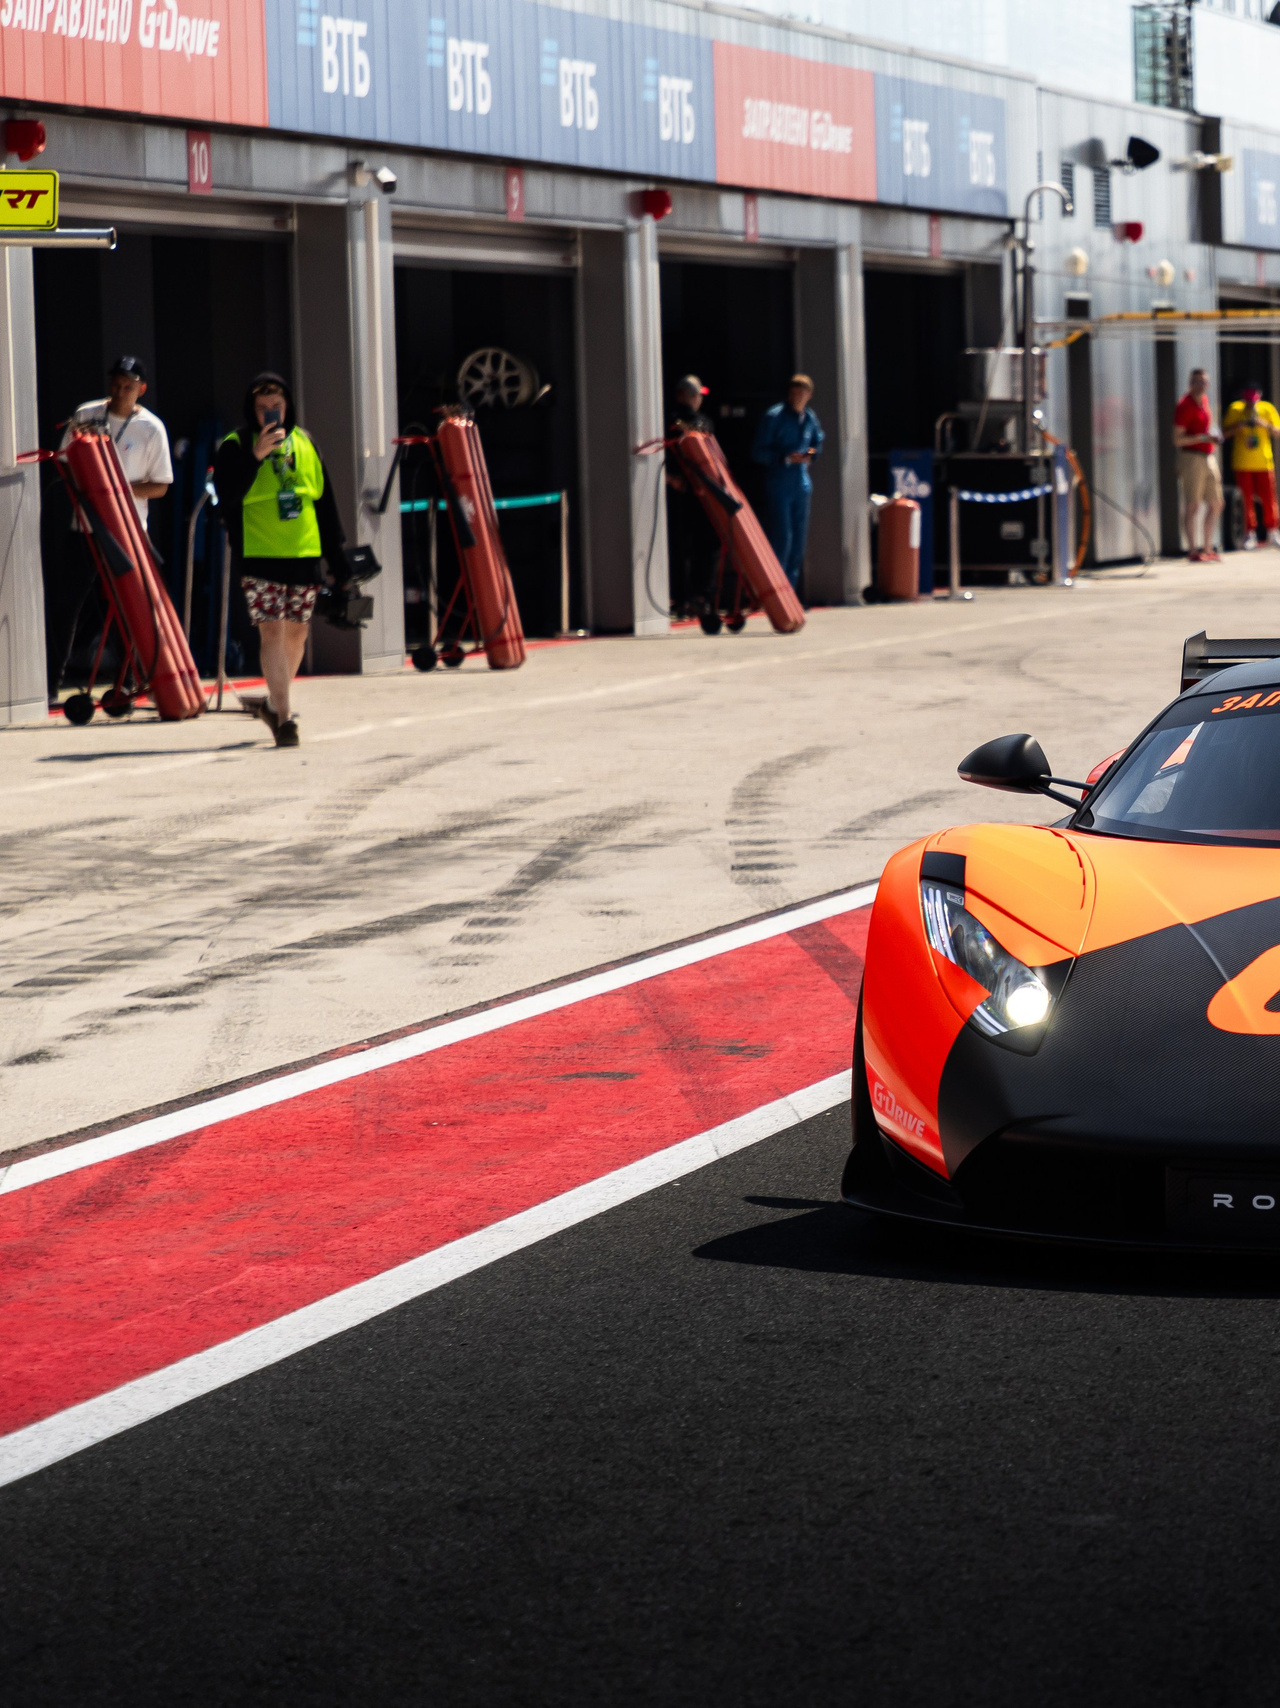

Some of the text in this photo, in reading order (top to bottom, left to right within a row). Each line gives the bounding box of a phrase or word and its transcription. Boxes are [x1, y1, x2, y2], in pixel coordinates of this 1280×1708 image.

[321, 15, 370, 98] ВТБ
[447, 37, 492, 115] ВТБ
[560, 57, 599, 130] ВТБ
[659, 75, 694, 144] ВТБ
[191, 140, 210, 184] 10
[0, 189, 49, 209] RT
